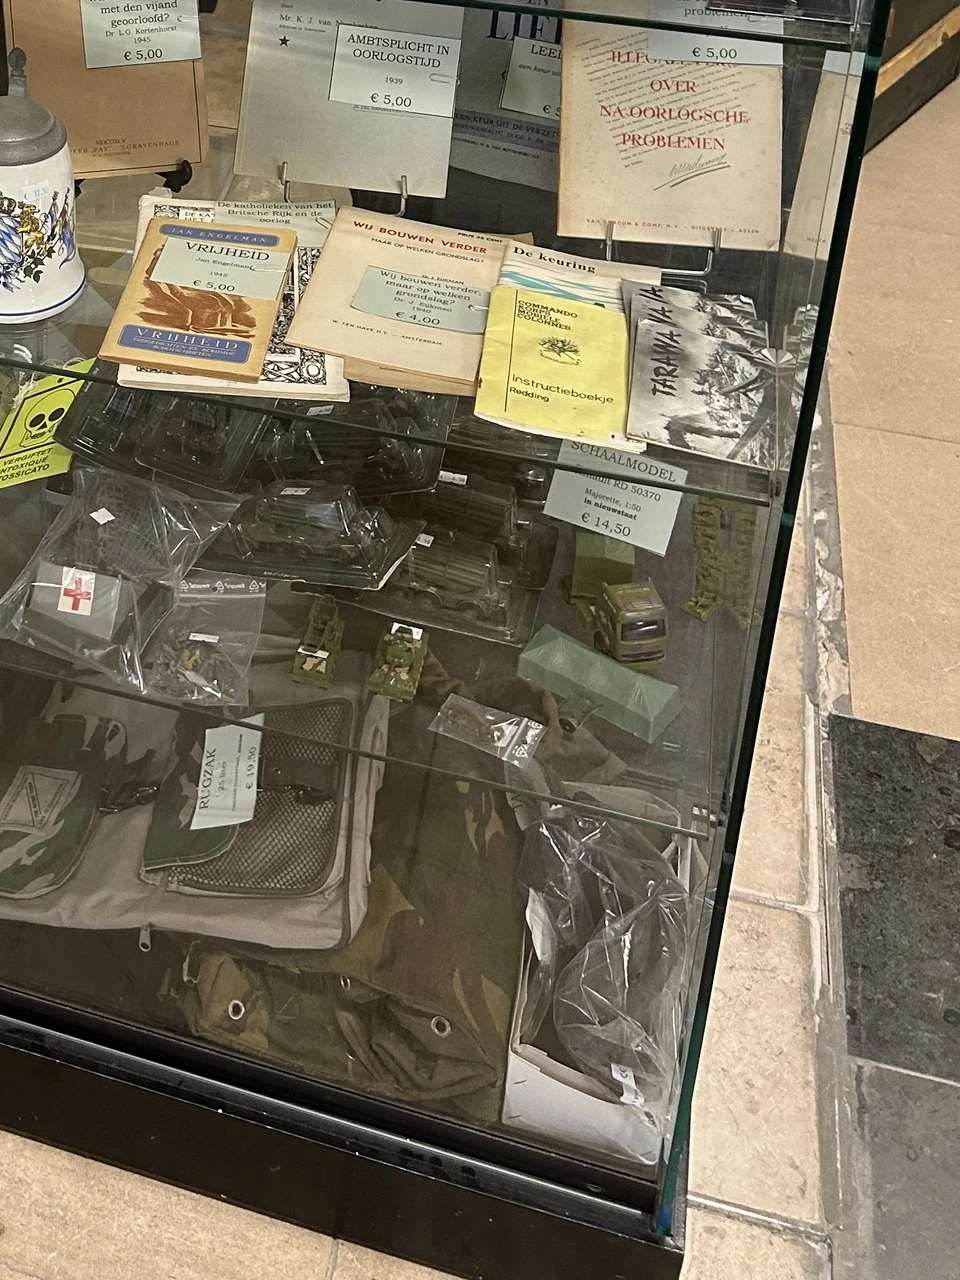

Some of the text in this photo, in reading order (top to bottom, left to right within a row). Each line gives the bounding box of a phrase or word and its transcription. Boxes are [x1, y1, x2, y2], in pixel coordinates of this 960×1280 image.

[100, 0, 178, 15] met den vijand
[110, 13, 170, 28] geoorloofd?
[133, 36, 152, 44] 1945
[347, 33, 450, 56] AMBTSPLICHT IN
[123, 48, 163, 62] € 5,00
[352, 48, 442, 69] OORLOGSTIJD
[692, 47, 737, 60] € 5,00
[385, 75, 404, 86] 1939
[650, 79, 696, 94] OVER
[370, 92, 412, 108] € 5,00
[622, 133, 726, 151] PROBLEMEN
[233, 202, 291, 210] katholieken
[353, 220, 488, 254] WIJ BOUWEN VERDER
[186, 241, 270, 261] VRIJHEID
[513, 245, 597, 274] De keuring
[205, 281, 235, 292] 5,00
[385, 280, 472, 302] maar op welken
[395, 289, 456, 306] grondslag?
[517, 299, 578, 319] COMMANDO
[136, 327, 239, 350] VRIJHEID
[649, 329, 683, 398] TARAWA
[509, 386, 550, 403] Redding
[511, 373, 615, 404] Instructieboekje
[2, 448, 54, 466] VERGIFTET
[571, 441, 677, 483] SCHAALMODEL
[583, 497, 638, 521] in nieuwstaat
[584, 488, 642, 512] Majorette, 1:50
[581, 512, 631, 538] € 14,50
[245, 746, 257, 789] € 19,50
[199, 748, 217, 810] RUGZAK
